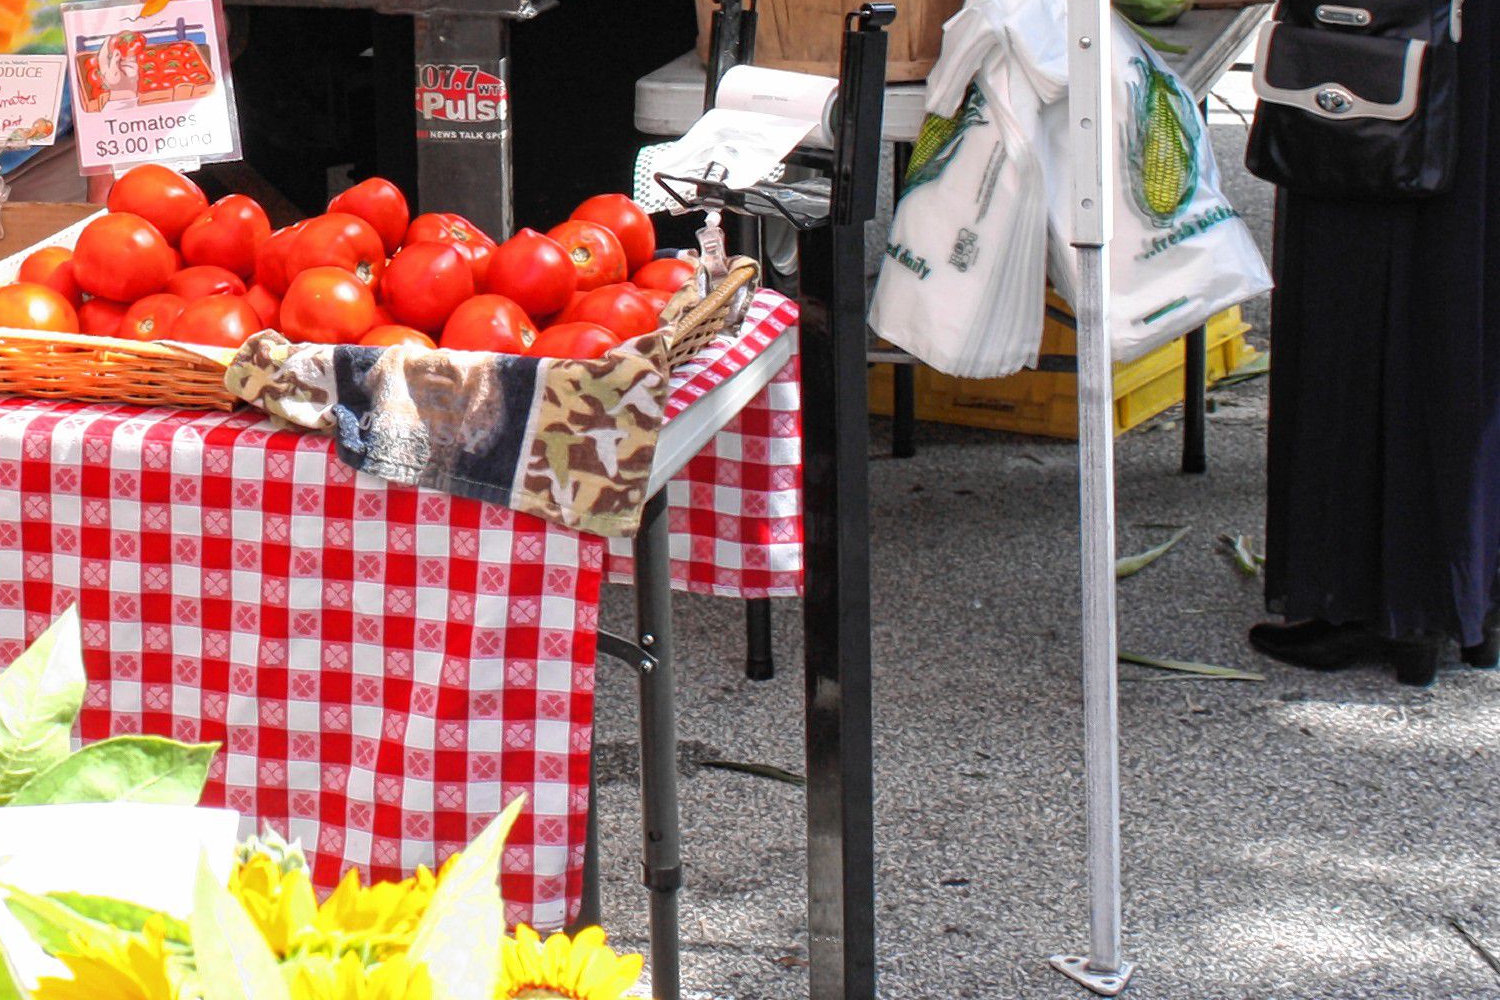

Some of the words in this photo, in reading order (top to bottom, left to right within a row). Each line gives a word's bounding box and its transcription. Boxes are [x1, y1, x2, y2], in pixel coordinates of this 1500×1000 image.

[104, 113, 197, 135] Tomatoes
[430, 130, 458, 139] NEWS
[460, 131, 484, 139] TALK
[96, 136, 148, 157] $3.00
[155, 130, 212, 153] pound
[899, 248, 932, 281] daily
